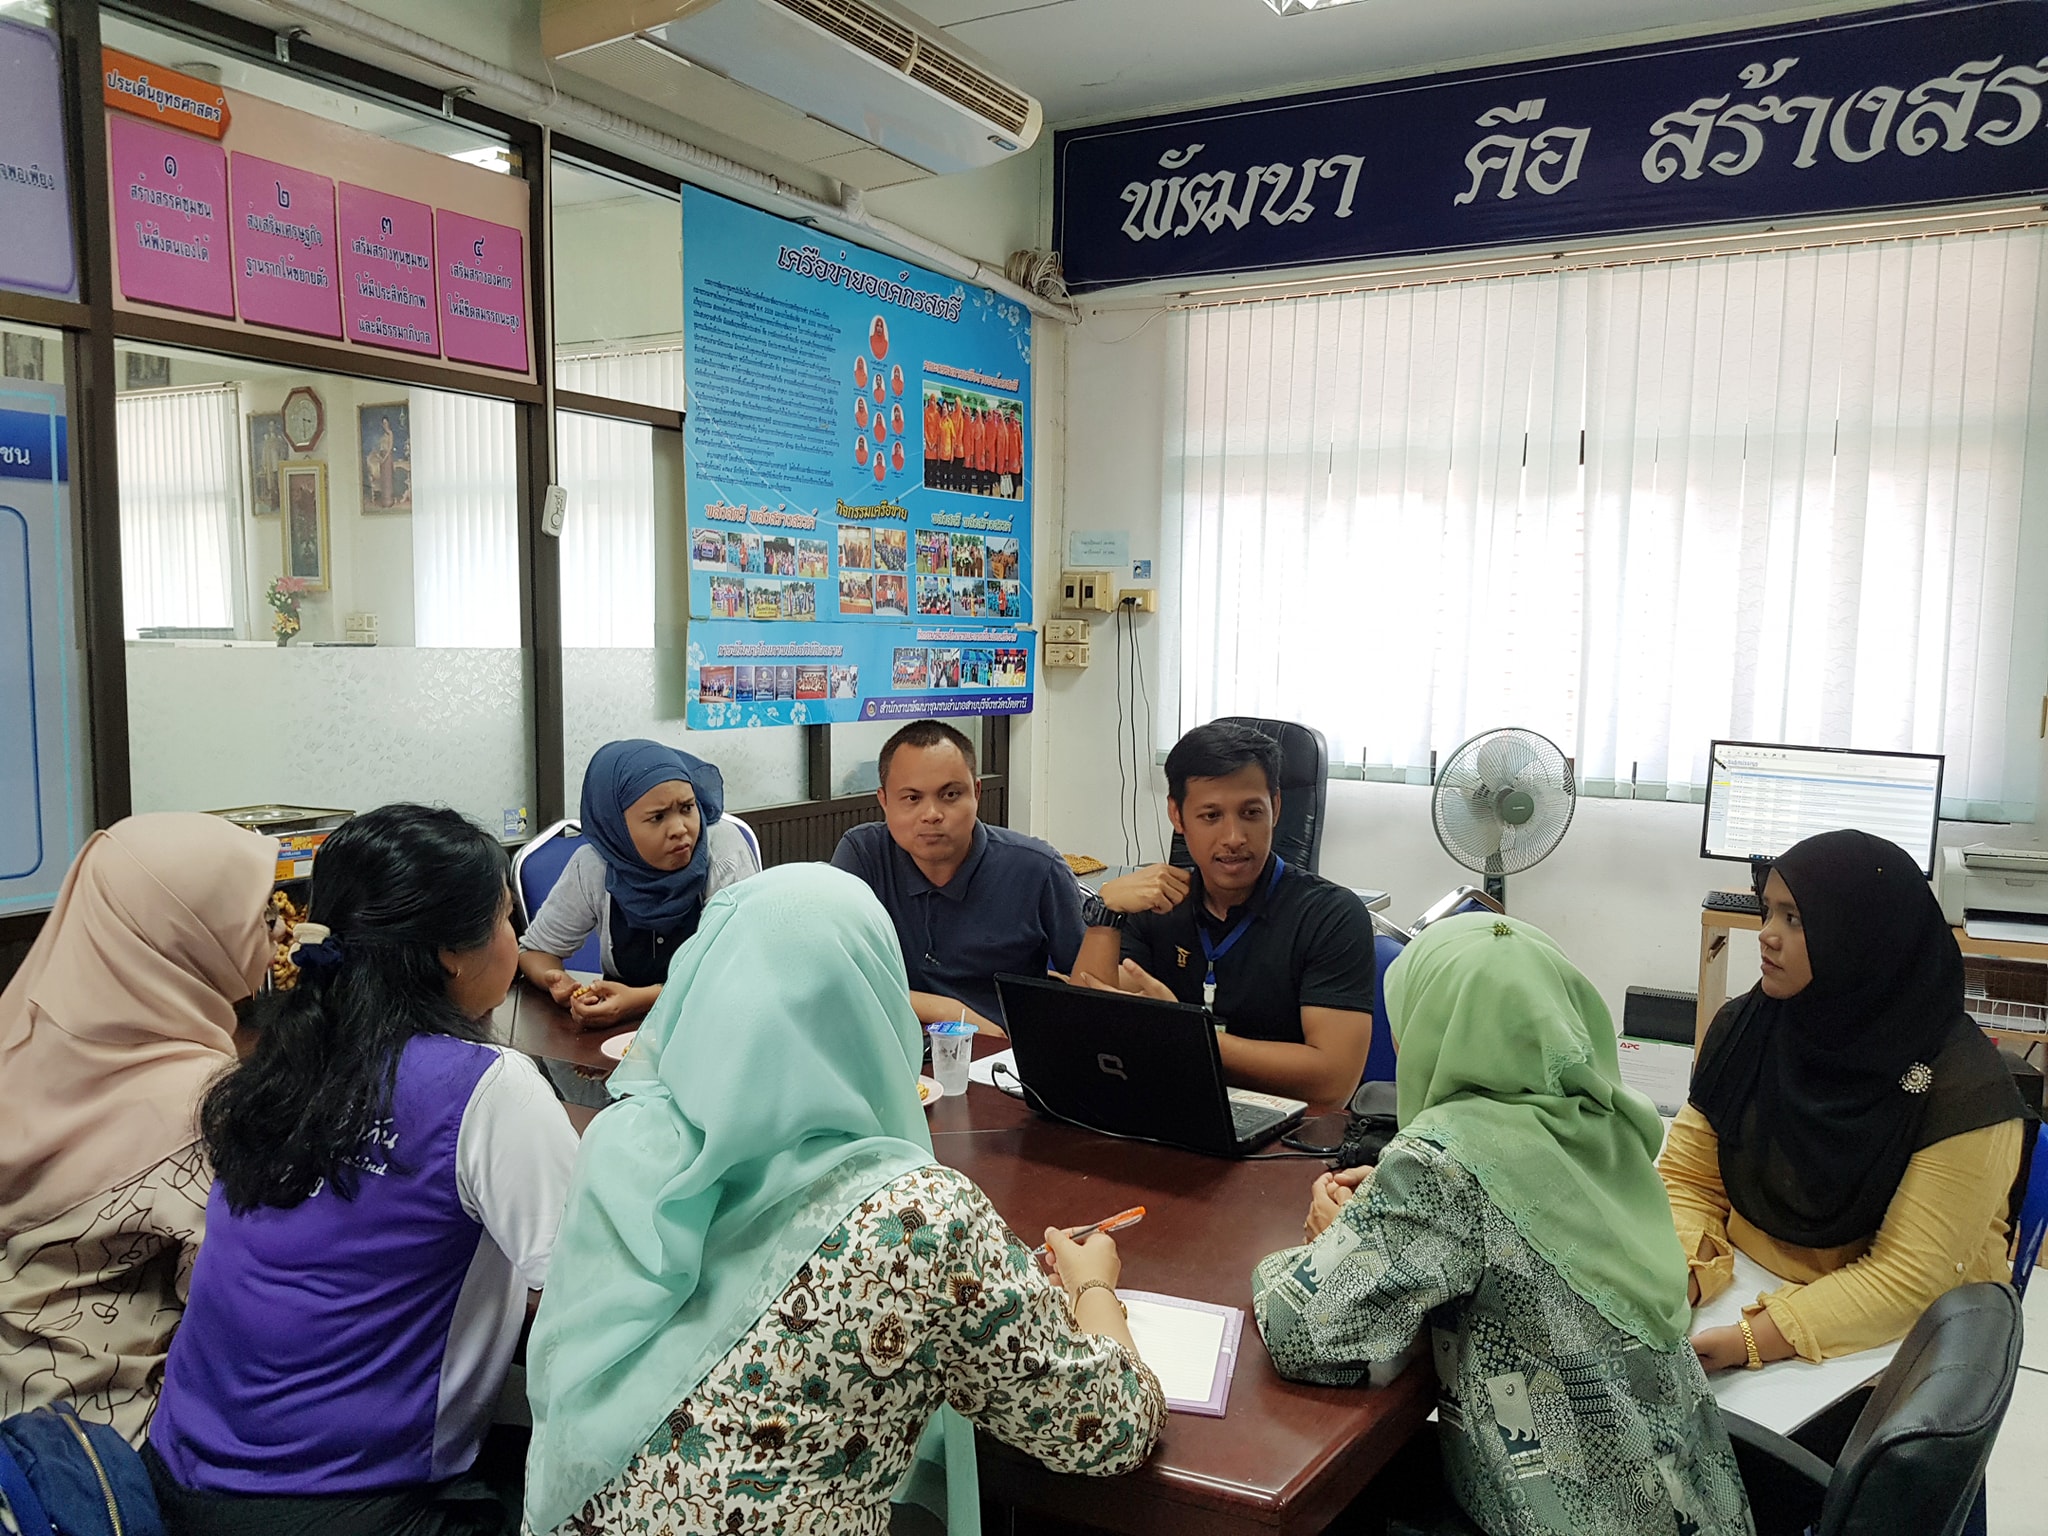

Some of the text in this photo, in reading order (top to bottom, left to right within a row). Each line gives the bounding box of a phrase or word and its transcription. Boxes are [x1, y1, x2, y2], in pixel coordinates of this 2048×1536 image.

[106, 70, 223, 122] ประเด็นยุทธศาสตร์
[1119, 53, 2048, 242] พัฒนา คือ สร้างสร
[164, 155, 178, 178] ๑
[130, 172, 214, 222] สร้างสรรค์ชุมชน
[275, 181, 291, 209] ๒
[135, 220, 209, 262] ให้พึ่งตนเองได้
[380, 216, 393, 236] ๓
[351, 235, 431, 274] เสริมสร้างทุนชุมชน
[473, 235, 486, 258] ๔
[246, 253, 329, 288] ฐานรากให้ขยายตัว
[449, 258, 514, 291] เสริมสร้างองค์กร
[776, 245, 964, 323] เครือข่ายองค์กรสตรี
[355, 271, 427, 310] ให้มีประสิทธิภาพ
[358, 316, 432, 345] และมีธรรมาภิบาล
[1619, 1041, 1640, 1051] APC
